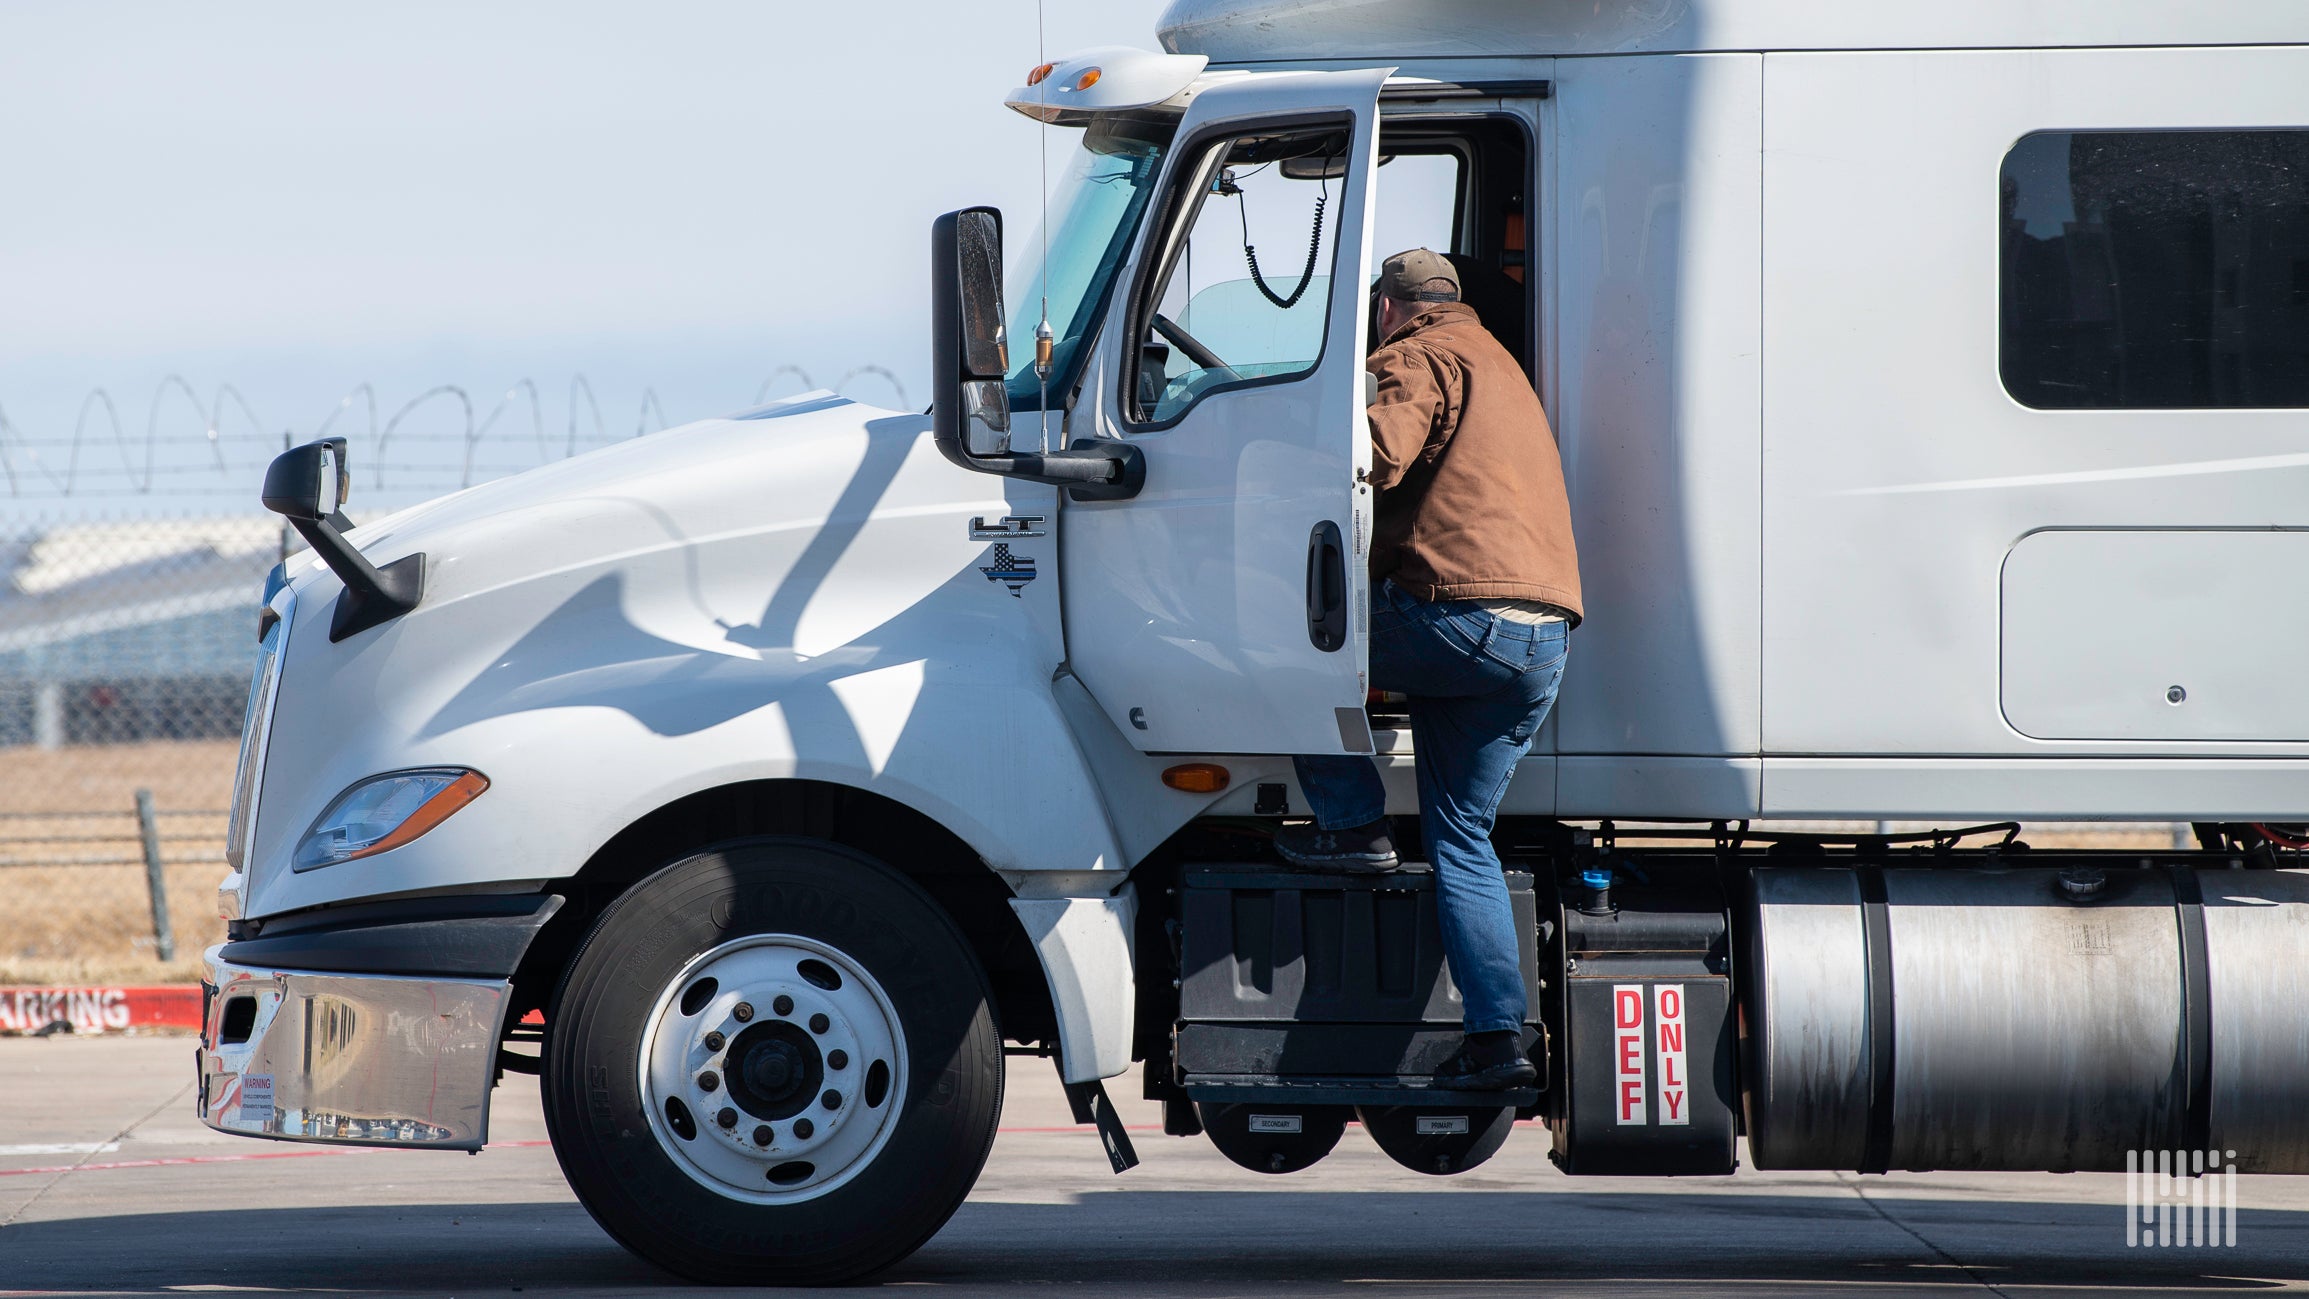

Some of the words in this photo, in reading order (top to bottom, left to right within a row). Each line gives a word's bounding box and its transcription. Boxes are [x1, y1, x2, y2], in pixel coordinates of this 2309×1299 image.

[973, 516, 1045, 531] LT
[1616, 990, 1642, 1120] DEF
[1660, 989, 1683, 1120] ONLY
[244, 1078, 270, 1088] WARNING
[1261, 1120, 1290, 1128] SECONDARY
[1431, 1121, 1454, 1129] PRIMARY
